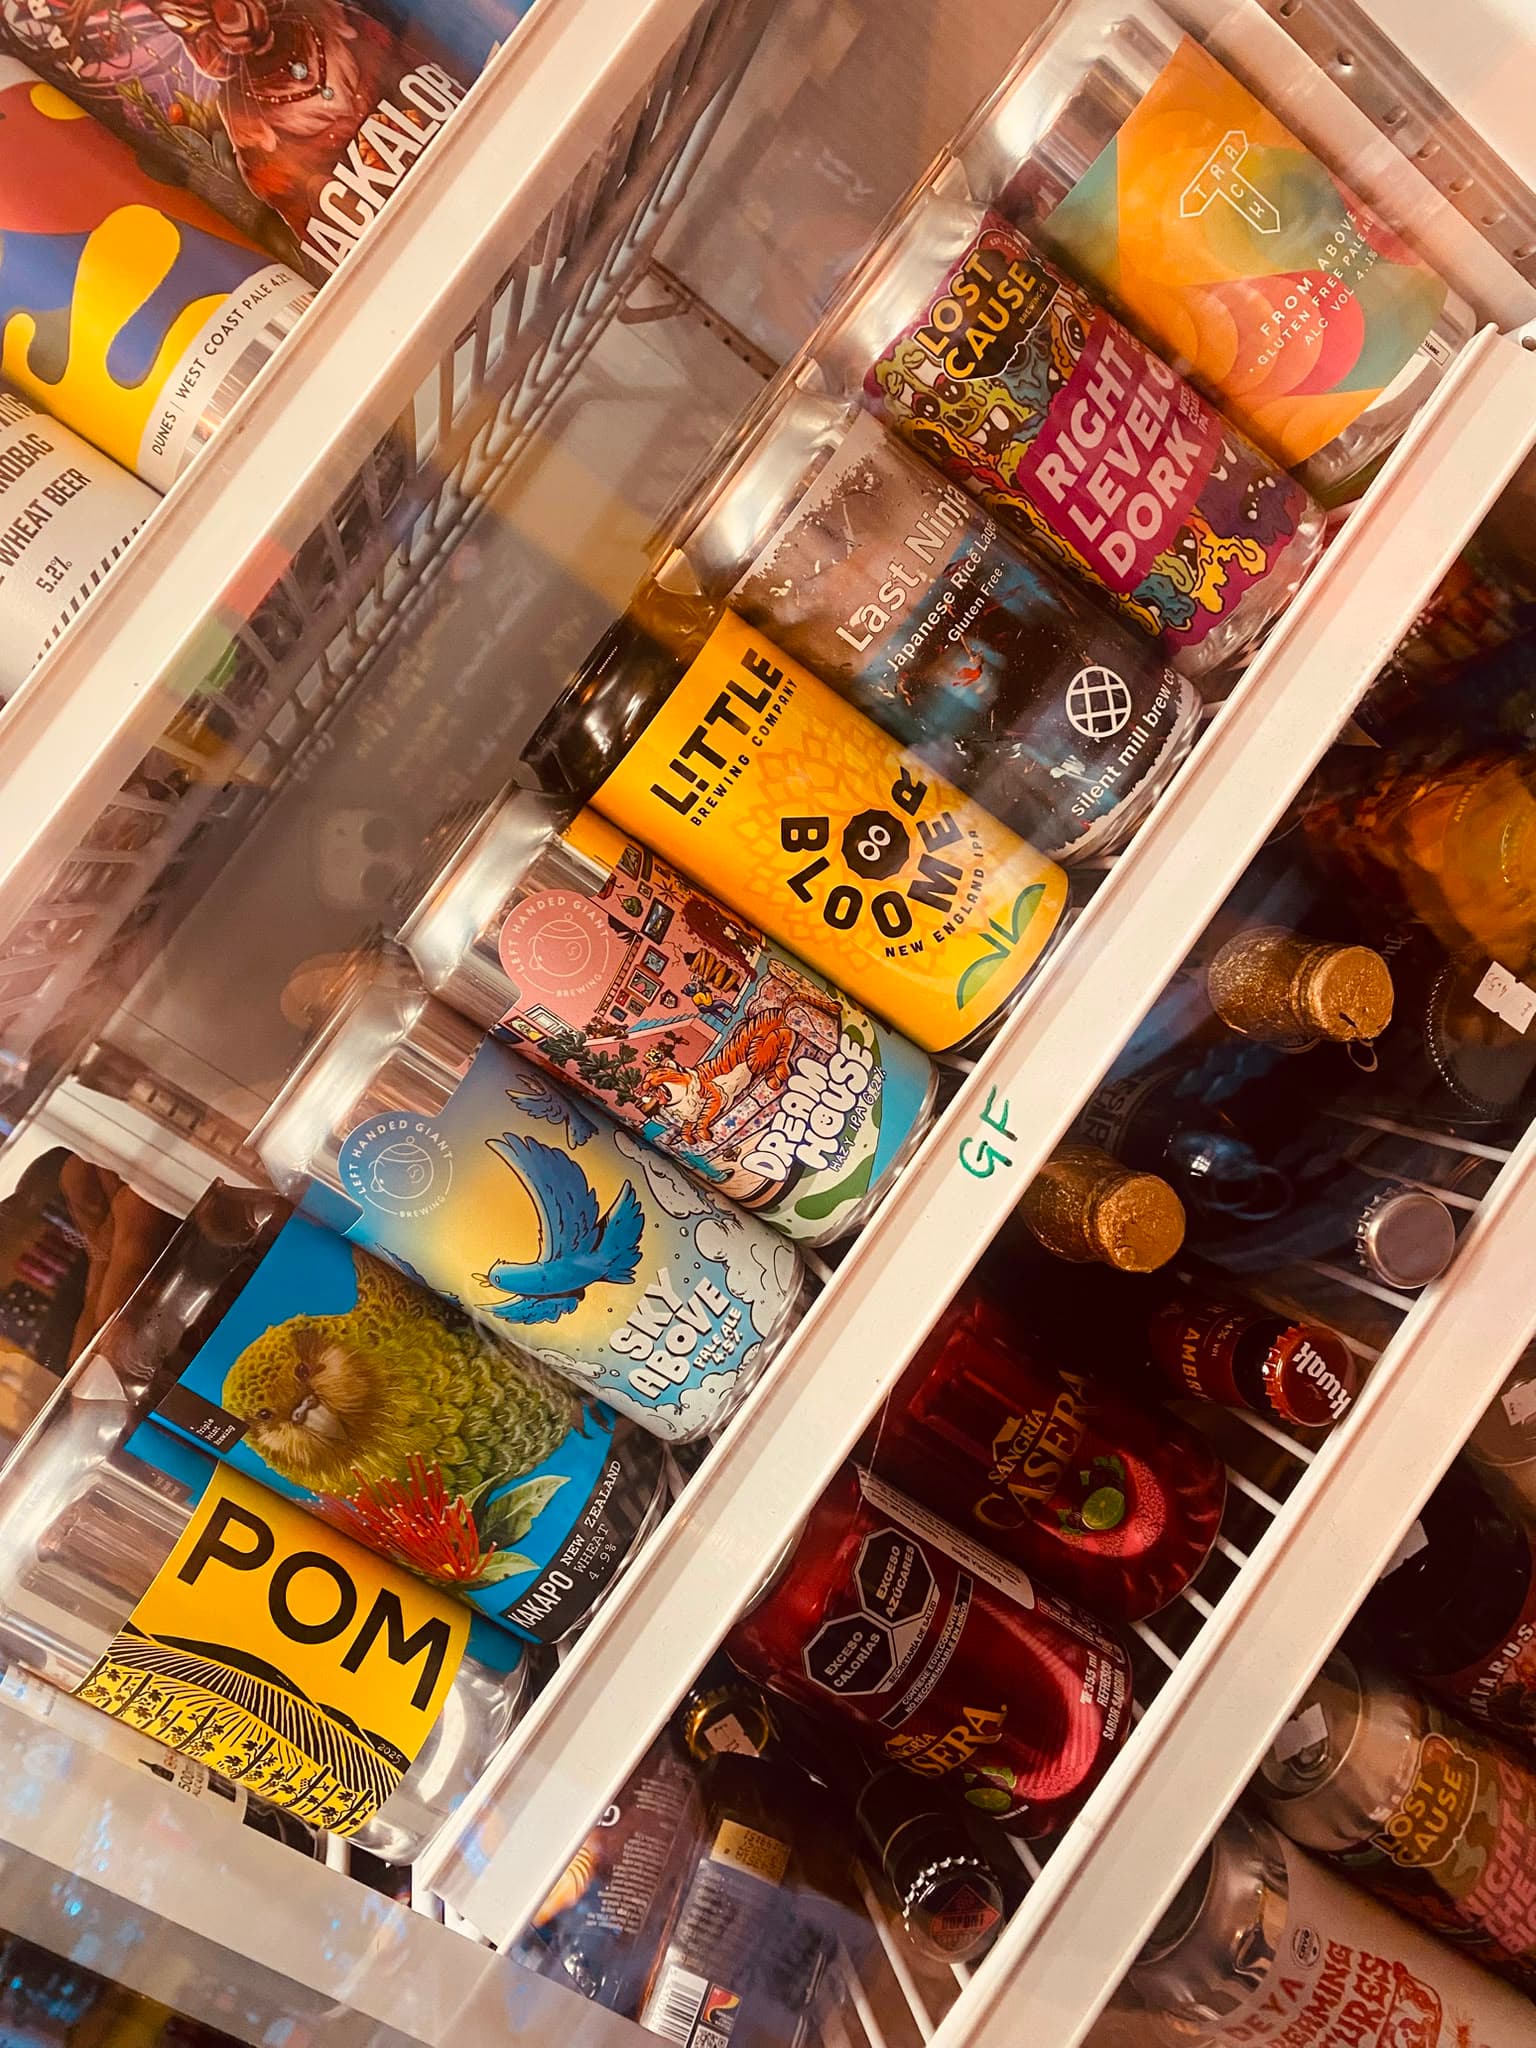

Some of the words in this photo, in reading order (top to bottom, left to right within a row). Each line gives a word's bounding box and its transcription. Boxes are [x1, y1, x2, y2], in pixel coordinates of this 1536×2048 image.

[916, 253, 993, 356] LOST
[1257, 309, 1311, 365] GLUTEN
[1312, 268, 1344, 307] FREE
[1343, 232, 1366, 266] PALE
[1260, 277, 1314, 337] FROM
[1317, 210, 1357, 271] ABOVE
[945, 262, 1037, 378] CAUSE
[1304, 317, 1329, 346] ALC
[1331, 287, 1354, 312] VOL
[151, 410, 177, 456] DUNES
[175, 357, 206, 399] WEST
[204, 308, 245, 355] COAST
[242, 284, 272, 310] PALE
[1035, 335, 1133, 504] RIGHT
[0, 433, 55, 494] NDBAG
[42, 467, 92, 508] BEER
[1068, 384, 1171, 543] LEVEL
[1099, 417, 1202, 579] DORK
[36, 556, 72, 593] 5.2%
[835, 561, 921, 652] Last
[904, 484, 970, 564] Ninja
[887, 590, 955, 672] Japanese
[950, 551, 981, 590] Rice
[974, 518, 997, 552] Lager
[948, 597, 985, 642] Gluten
[980, 566, 1003, 598] Free
[690, 754, 751, 826] BREWING
[751, 678, 798, 747] COMPANY
[1071, 765, 1121, 817] silent
[1118, 725, 1150, 766] mill
[1142, 683, 1173, 728] brew
[781, 766, 964, 938] BLOOMER
[511, 896, 566, 934] HANDED
[573, 900, 609, 937] GIANT
[885, 940, 924, 958] NEW
[932, 868, 985, 943] ENGLAND
[968, 830, 984, 858] IPA
[508, 939, 525, 973] LEFT
[556, 973, 603, 997] BREWING
[741, 1057, 830, 1181] DREAM
[795, 1033, 874, 1170] HOUSE
[829, 1136, 856, 1172] HAZY
[849, 1105, 867, 1132] IPA
[862, 1066, 887, 1106] 6.2%
[351, 1120, 408, 1158] HANDED
[415, 1123, 453, 1159] GIANT
[349, 1163, 367, 1195] LEFT
[399, 1195, 446, 1218] BREWING
[609, 1267, 683, 1360] SKY
[628, 1277, 731, 1400] ABOVE
[693, 1333, 722, 1370] PALE
[721, 1307, 742, 1338] ALE
[711, 1329, 743, 1364] 4.5%
[974, 1370, 1090, 1529] CASERA
[507, 1570, 574, 1629] KAKAPO
[559, 1533, 586, 1566] NEW
[583, 1460, 622, 1528] ZEALAND
[573, 1523, 609, 1573] WHEAT
[588, 1543, 617, 1581] 4.9%
[875, 1545, 901, 1600] EXCESO
[176, 1496, 452, 1713] POM
[885, 1544, 915, 1618] AZÚCARES
[923, 1600, 937, 1628] SALUD
[824, 1631, 863, 1676] EXCESO
[833, 1632, 881, 1688] CALORÍAS
[902, 1669, 931, 1706] CONTIENE
[905, 1701, 916, 1713] NO
[914, 1643, 953, 1705] RECOMENDABLE
[1097, 1660, 1112, 1707] REFRESCO
[377, 1743, 403, 1764] 2025
[1103, 1706, 1121, 1740] SABOR
[1375, 1773, 1434, 1850] LOST
[1397, 1764, 1462, 1863] CAUSE
[1221, 1978, 1305, 2041] DEYA
